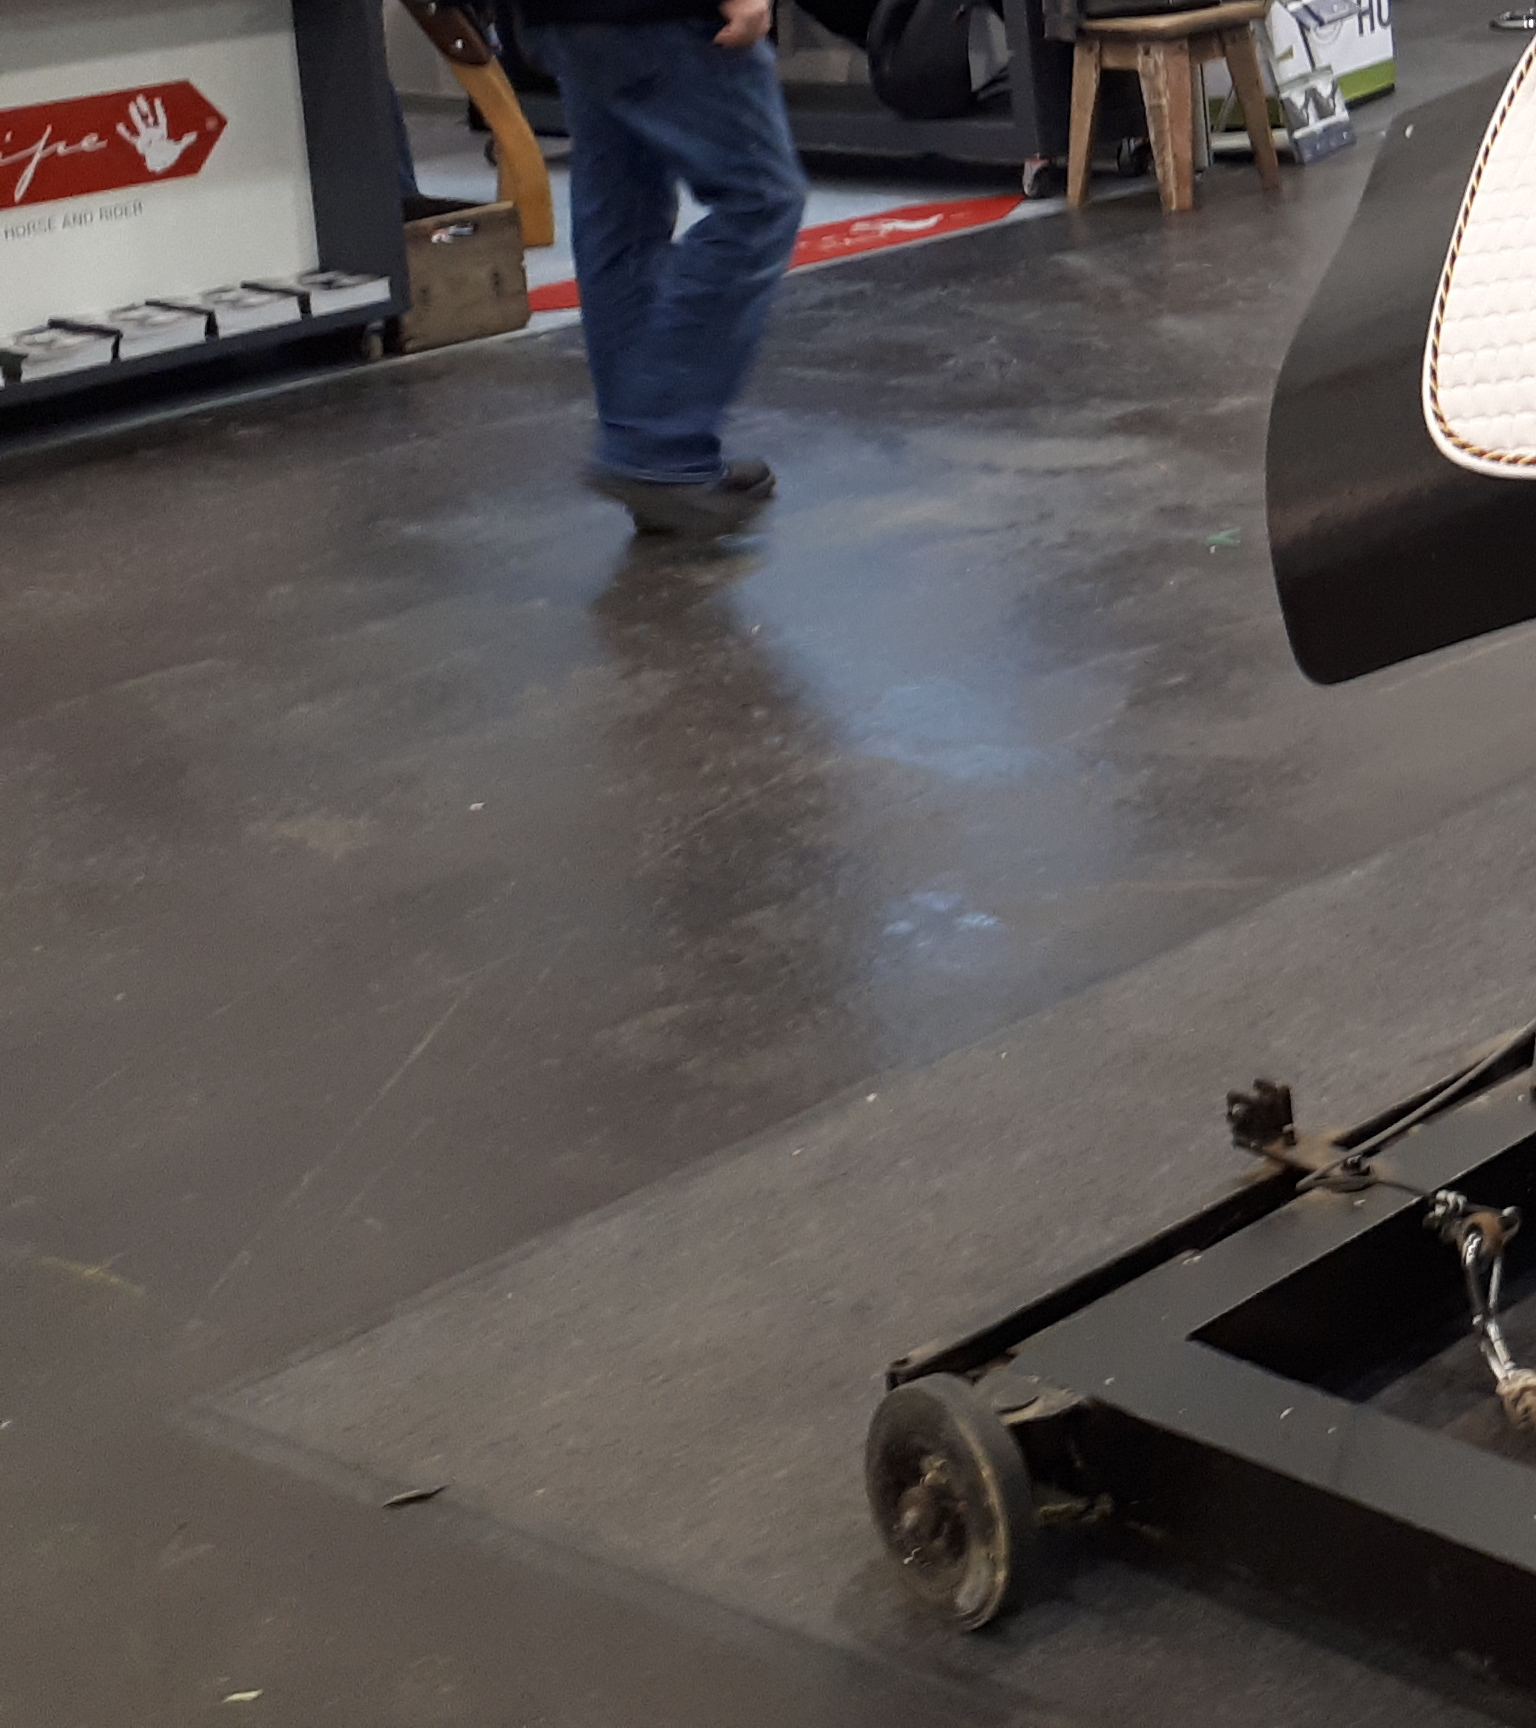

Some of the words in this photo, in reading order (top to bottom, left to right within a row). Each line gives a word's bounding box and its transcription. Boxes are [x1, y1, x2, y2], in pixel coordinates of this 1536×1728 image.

[3, 217, 54, 240] HORSE
[61, 210, 94, 230] AND
[99, 201, 143, 221] RIDER
